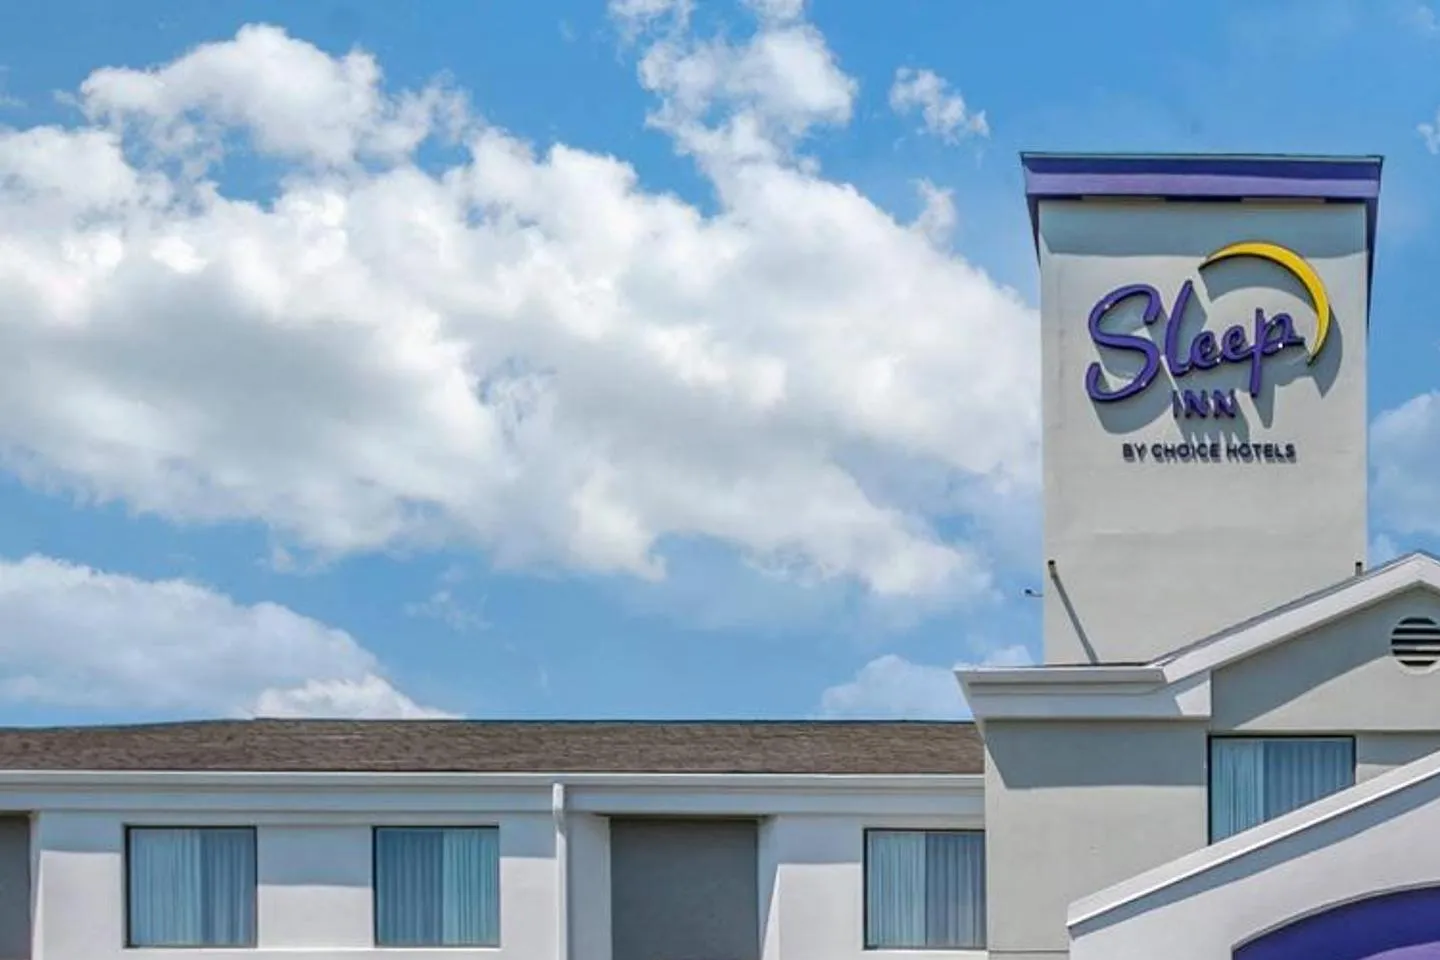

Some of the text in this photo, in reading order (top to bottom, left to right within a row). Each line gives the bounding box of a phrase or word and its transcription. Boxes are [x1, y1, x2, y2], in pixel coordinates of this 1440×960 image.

[1085, 279, 1305, 403] Sleep
[1172, 388, 1237, 419] INN
[1122, 442, 1296, 459] BY CHOICE HOTELS
